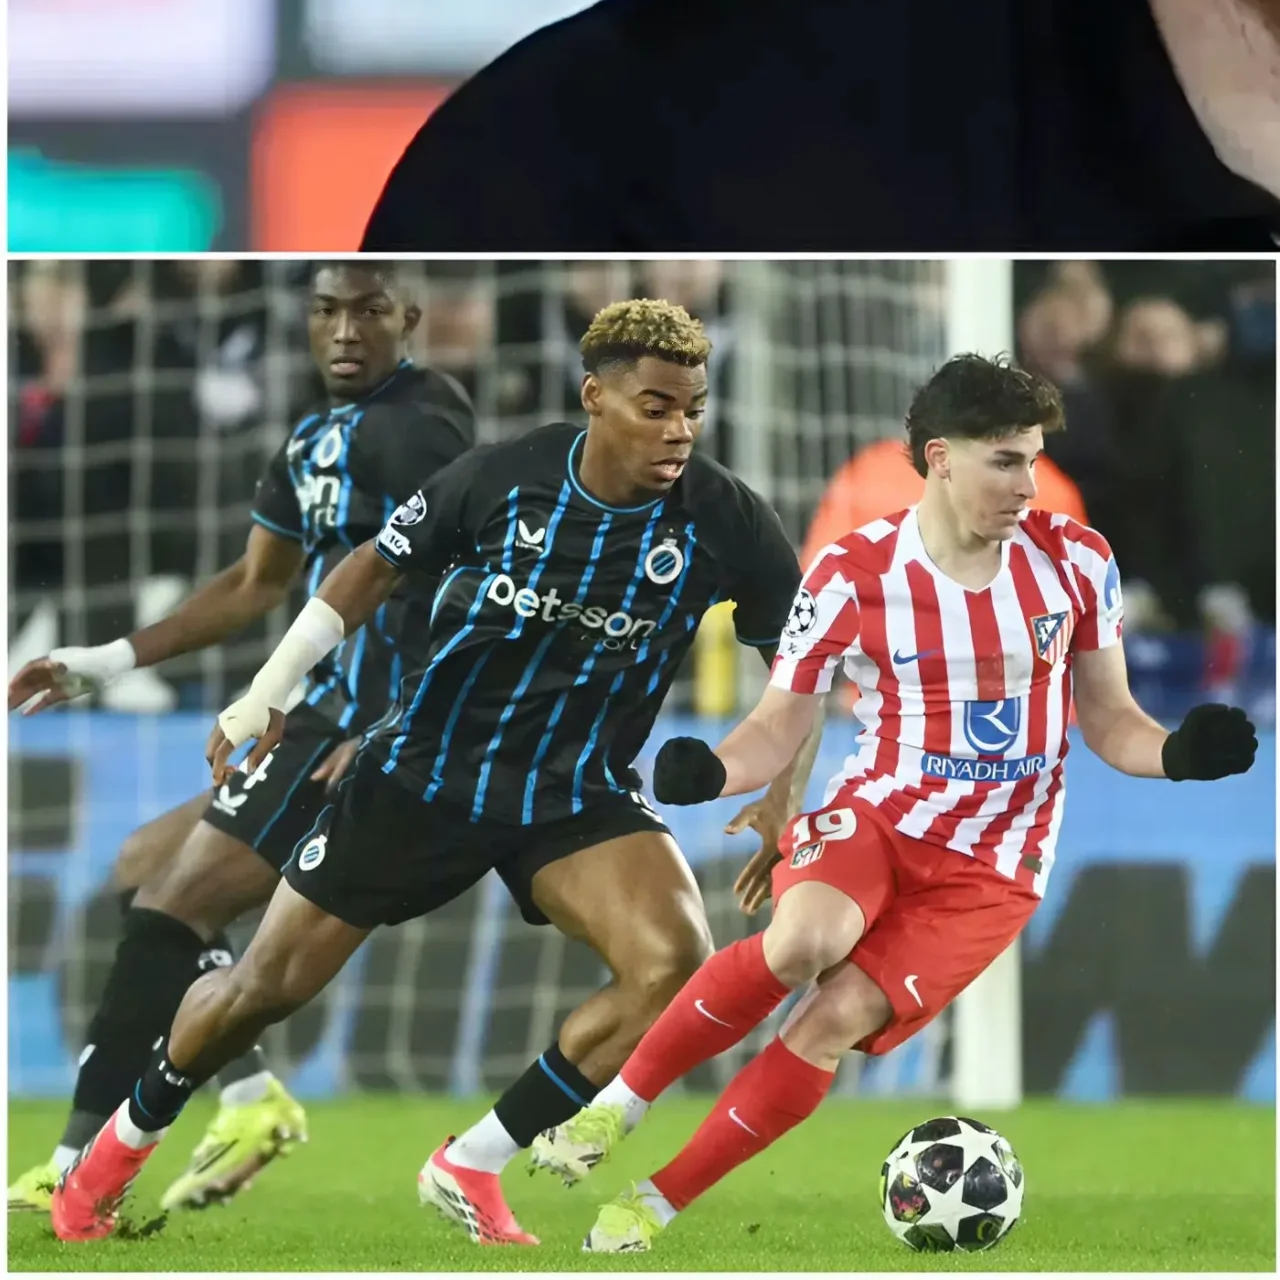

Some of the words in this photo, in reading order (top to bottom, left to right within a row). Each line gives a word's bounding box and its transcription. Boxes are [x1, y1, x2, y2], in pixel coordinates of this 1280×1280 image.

[487, 574, 656, 638] betsson
[926, 755, 1009, 780] RIYADH
[1013, 756, 1043, 779] AIR
[792, 808, 857, 849] 19
